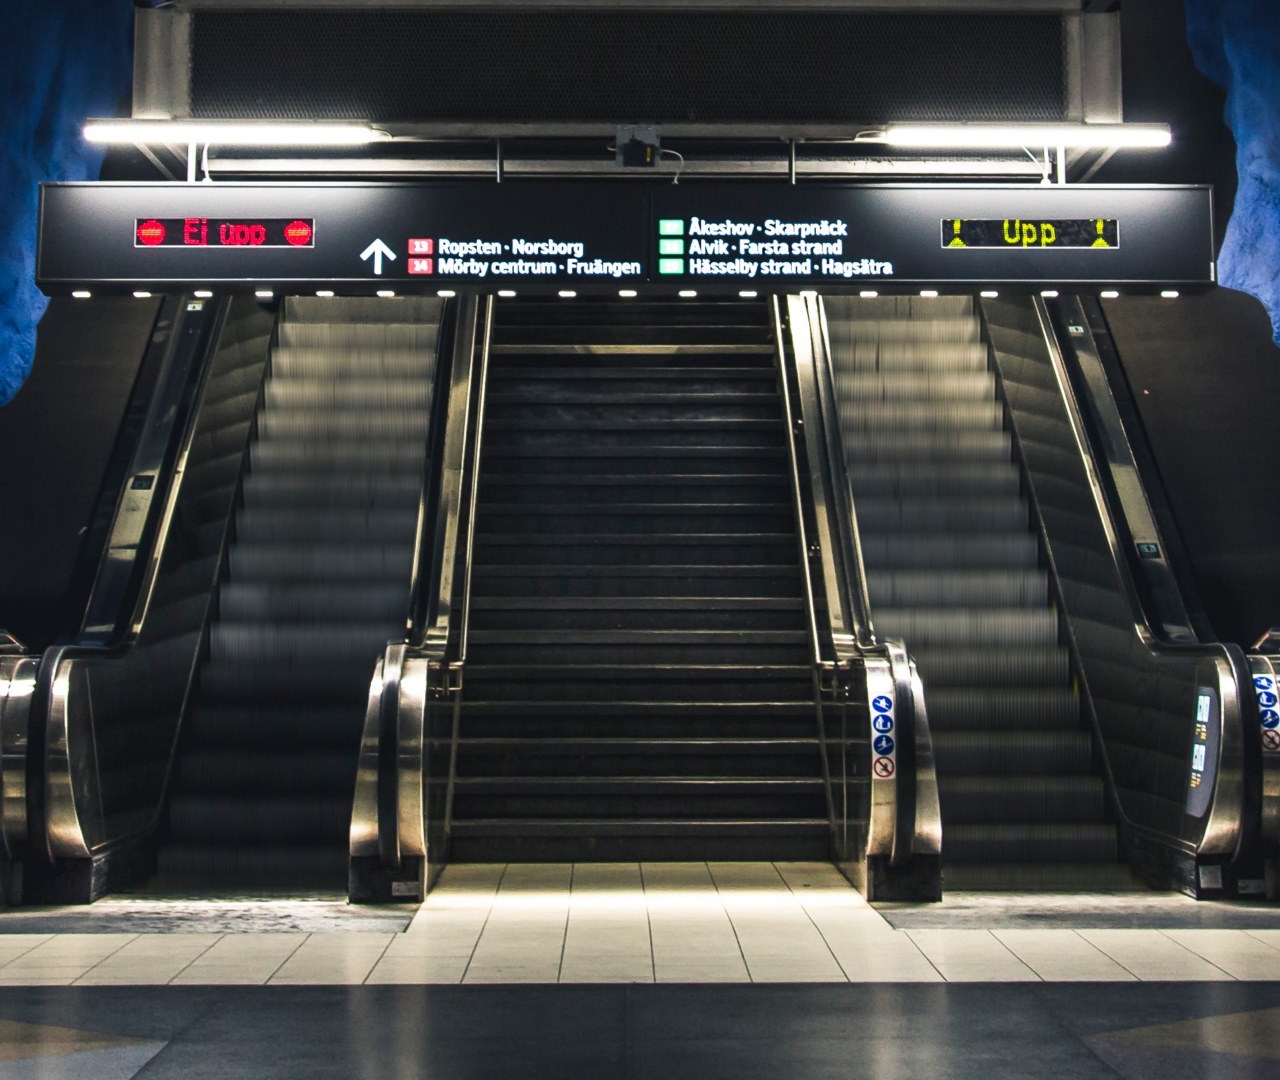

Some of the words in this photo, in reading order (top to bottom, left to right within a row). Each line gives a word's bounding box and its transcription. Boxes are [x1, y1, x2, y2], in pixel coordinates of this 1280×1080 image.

[689, 216, 755, 236] Åkeshov
[765, 219, 848, 238] Skarpnäck
[1003, 219, 1056, 247] Upp
[438, 238, 502, 257] Ropsten
[512, 238, 584, 257] Norsborg
[689, 238, 729, 255] Alvik
[739, 238, 790, 255] Farsta
[792, 238, 842, 255] strand
[413, 260, 429, 272] 14
[438, 258, 489, 277] Mörby
[491, 259, 557, 275] centrum
[567, 258, 641, 277] Fruängen
[689, 258, 758, 278] Hässelby
[761, 258, 812, 275] strand
[822, 258, 894, 277] Hagsätra
